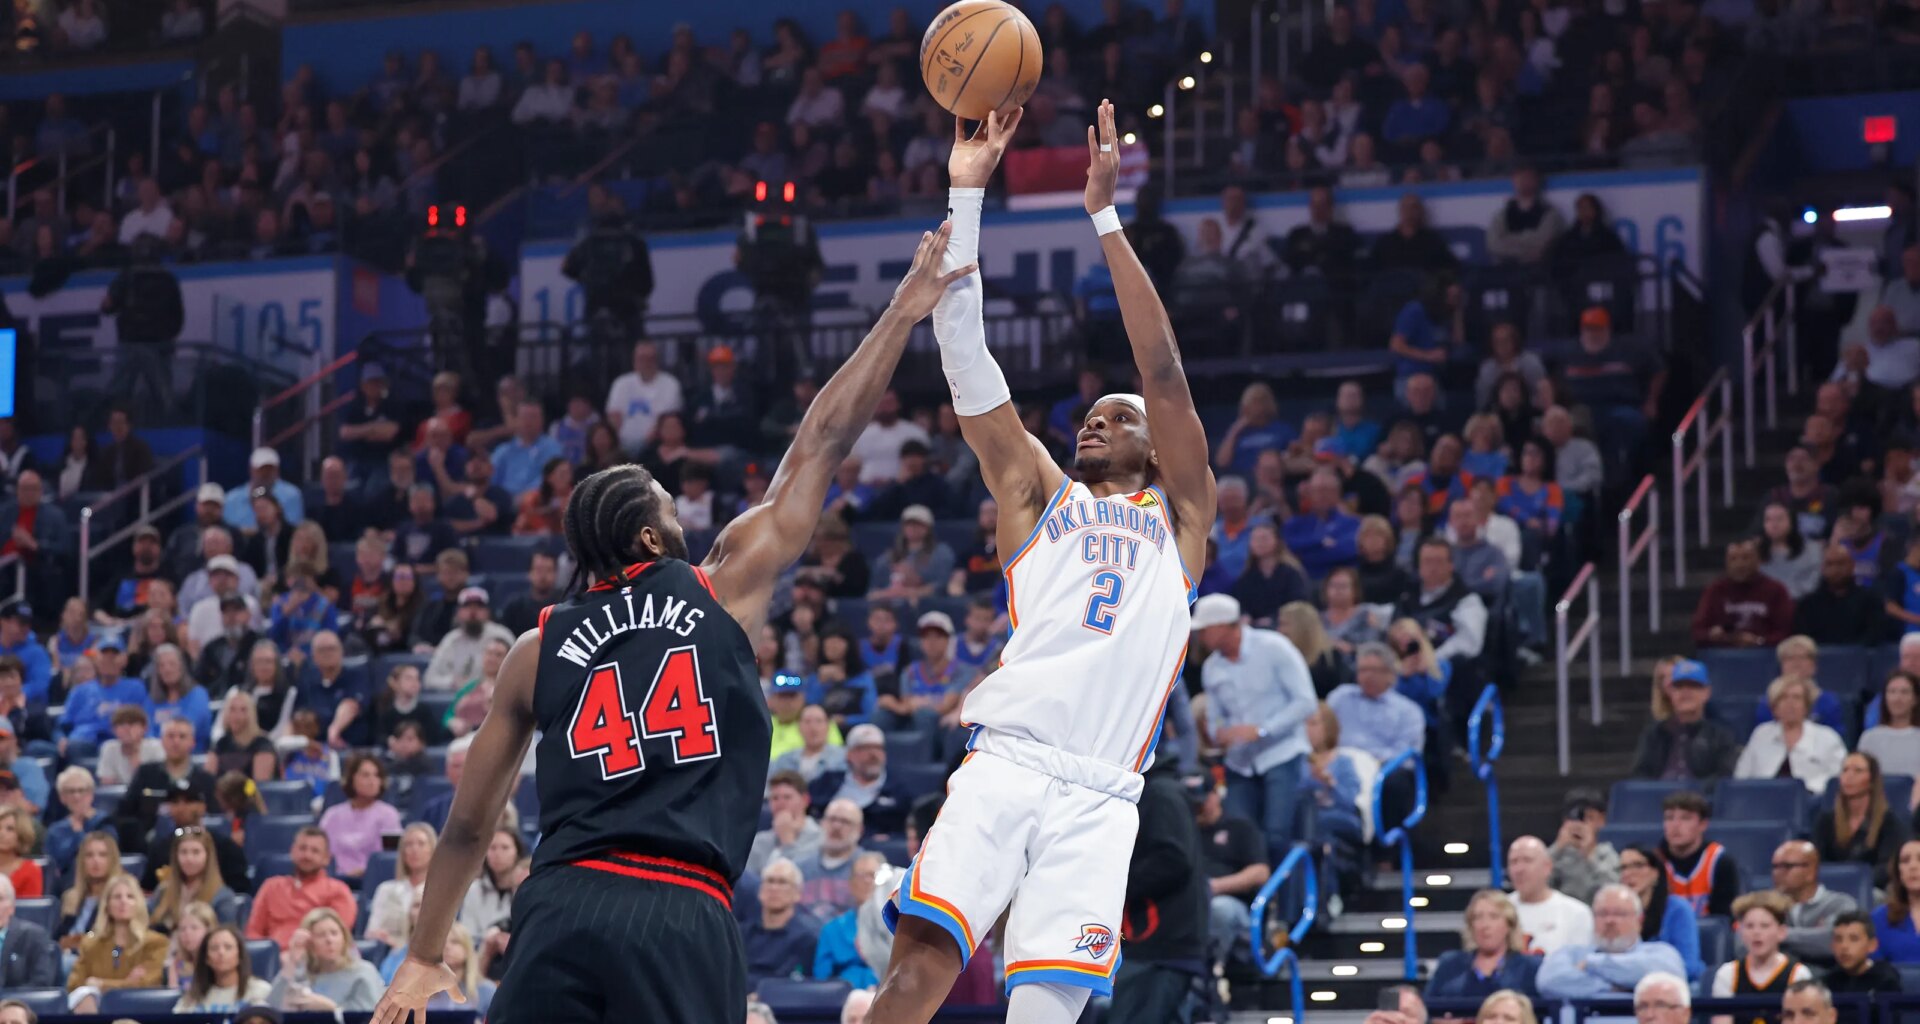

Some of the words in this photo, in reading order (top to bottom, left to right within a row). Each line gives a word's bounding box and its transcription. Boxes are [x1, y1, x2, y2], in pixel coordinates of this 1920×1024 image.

[1613, 214, 1685, 278] 06
[229, 299, 322, 357] 105
[1044, 499, 1167, 555] OKLAHOMA
[1081, 532, 1141, 571] CITY
[556, 593, 705, 668] WILLIAMS
[1081, 568, 1125, 636] 2
[566, 644, 721, 781] 44
[1075, 932, 1109, 949] OKC
